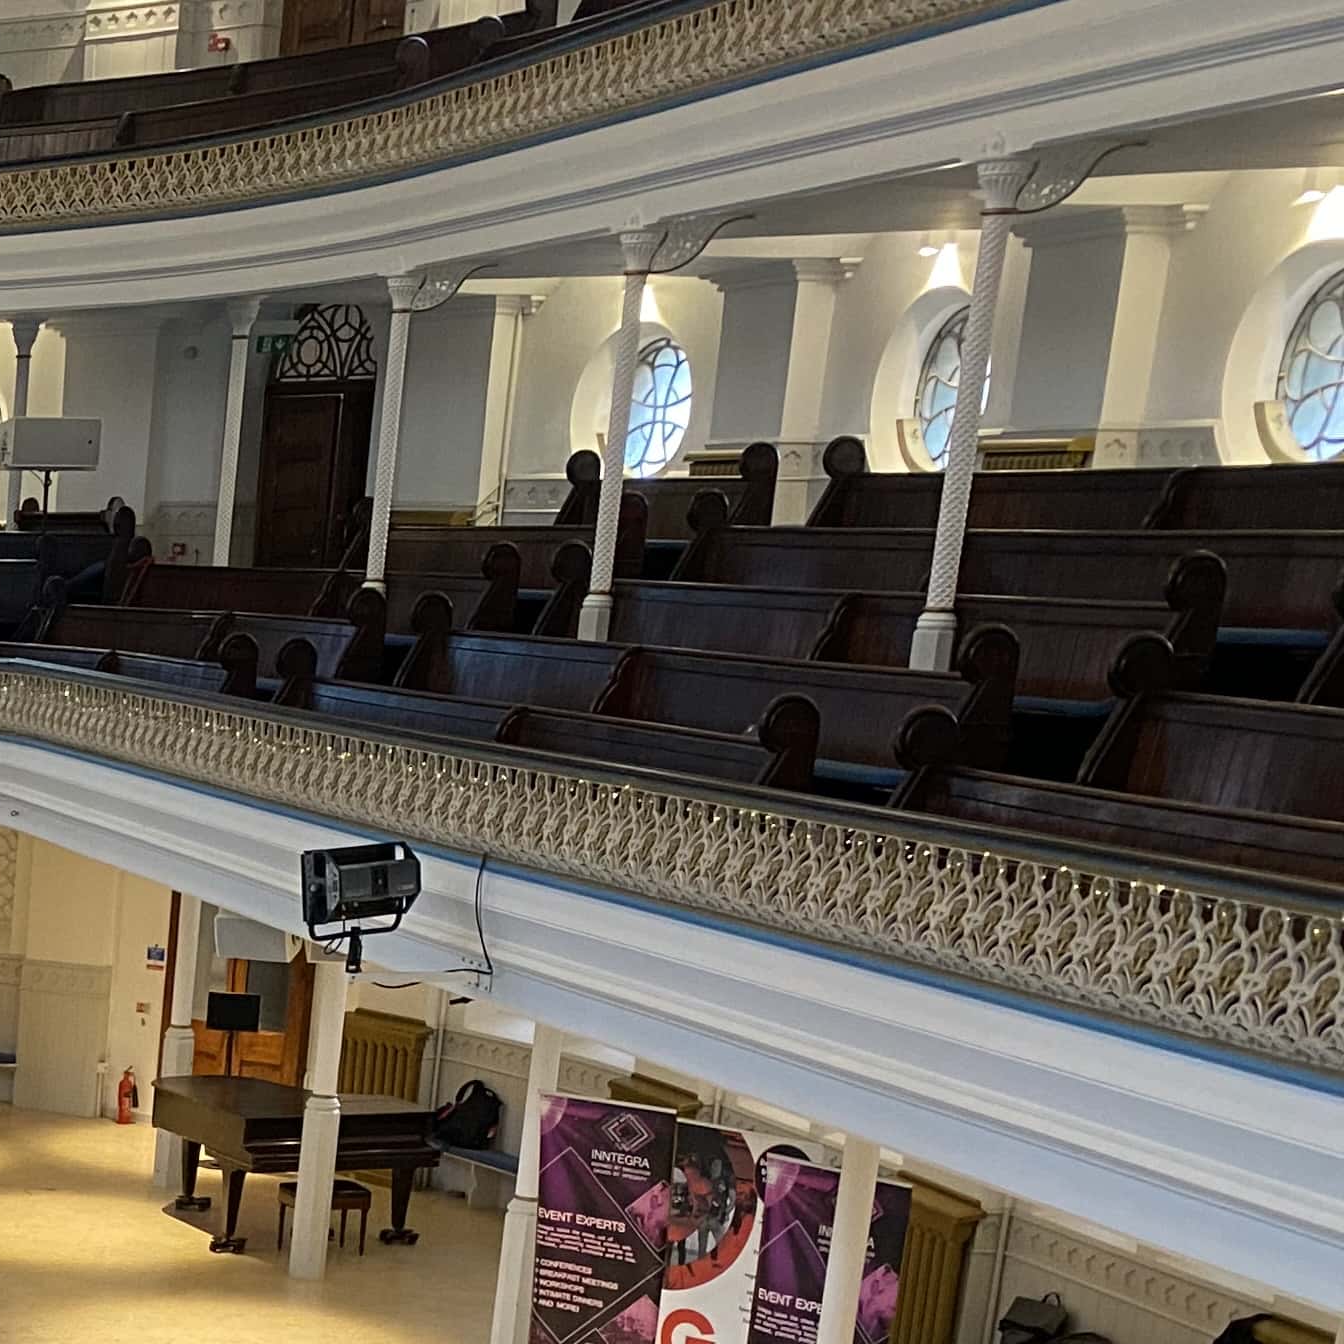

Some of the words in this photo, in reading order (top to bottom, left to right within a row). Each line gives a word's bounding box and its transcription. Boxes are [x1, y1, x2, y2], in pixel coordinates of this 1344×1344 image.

[591, 1149, 650, 1169] INNTEGRA
[538, 1206, 573, 1223] EVENT
[575, 1214, 626, 1233] EXPERTS
[540, 1258, 593, 1275] CONFERENCES
[539, 1268, 580, 1282] BREAKFAST
[581, 1277, 619, 1291] MEETINGS
[539, 1278, 585, 1294] WORKSHOPS
[538, 1288, 571, 1301] INTIMATE
[572, 1295, 604, 1309] DINNERS
[538, 1298, 554, 1307] AND
[556, 1301, 580, 1313] MORE!
[758, 1287, 794, 1307] EVENT
[794, 1297, 823, 1314] EXPE
